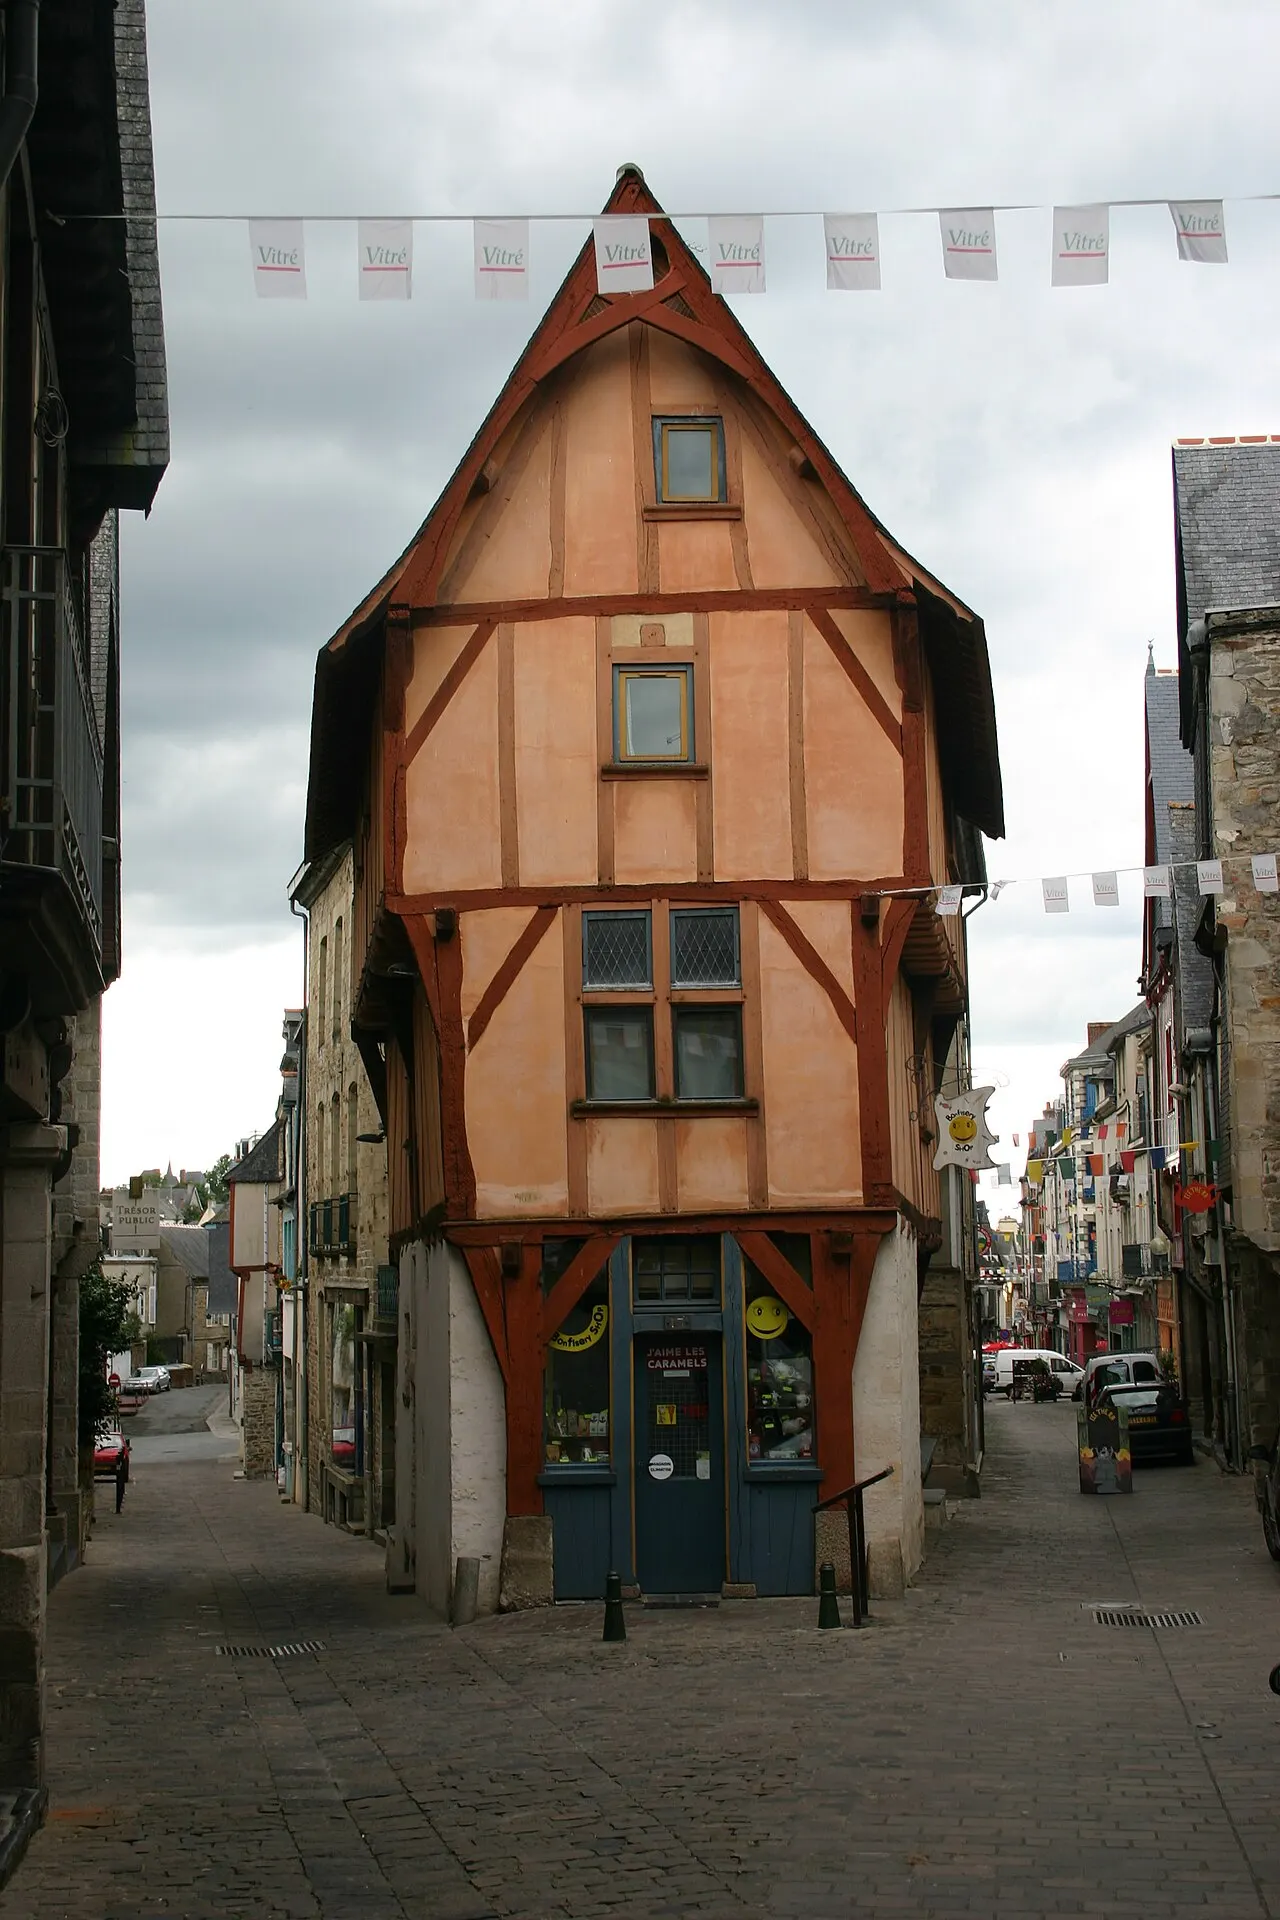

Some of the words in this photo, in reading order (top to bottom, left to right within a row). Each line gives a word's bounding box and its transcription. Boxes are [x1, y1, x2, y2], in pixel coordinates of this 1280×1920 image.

[1179, 214, 1219, 231] Vitré
[831, 236, 872, 256] Vitré
[948, 229, 990, 247] Vitré
[1063, 232, 1104, 251] Vitré
[258, 245, 298, 265] Vitré
[366, 245, 407, 265] Vitré
[482, 246, 523, 265] Vitré
[604, 243, 646, 262] Vitré
[718, 243, 760, 261] Vitré
[1147, 876, 1166, 884] Vitré
[1255, 867, 1274, 877] Vitré
[116, 1205, 157, 1215] TRÉSOR
[119, 1216, 155, 1224] PUBLIC
[647, 1347, 682, 1357] J'AIME
[685, 1346, 706, 1356] LES
[647, 1358, 708, 1369] CARAMELS
